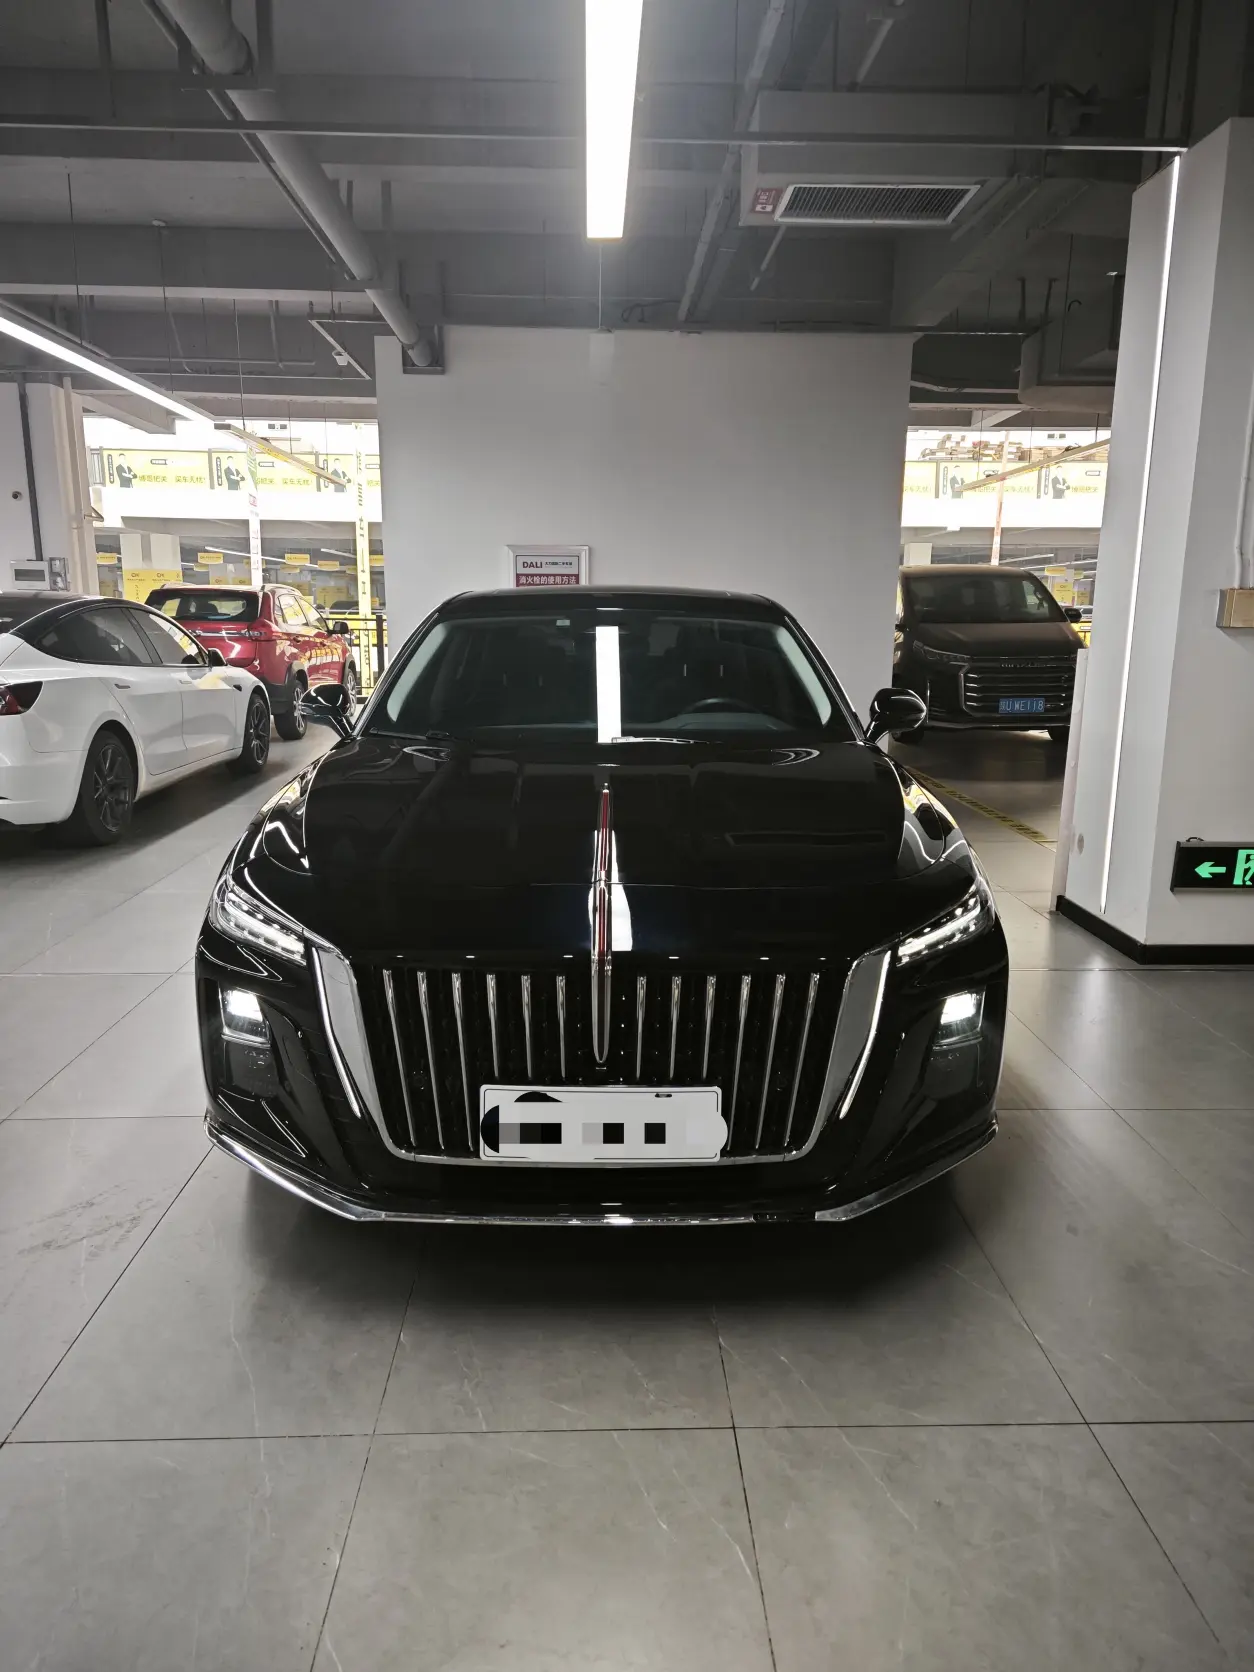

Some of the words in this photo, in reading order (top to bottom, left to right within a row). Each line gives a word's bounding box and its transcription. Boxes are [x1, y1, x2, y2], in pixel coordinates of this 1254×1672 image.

[522, 561, 543, 569] DALI
[518, 575, 577, 585] 消火栓的使用方法
